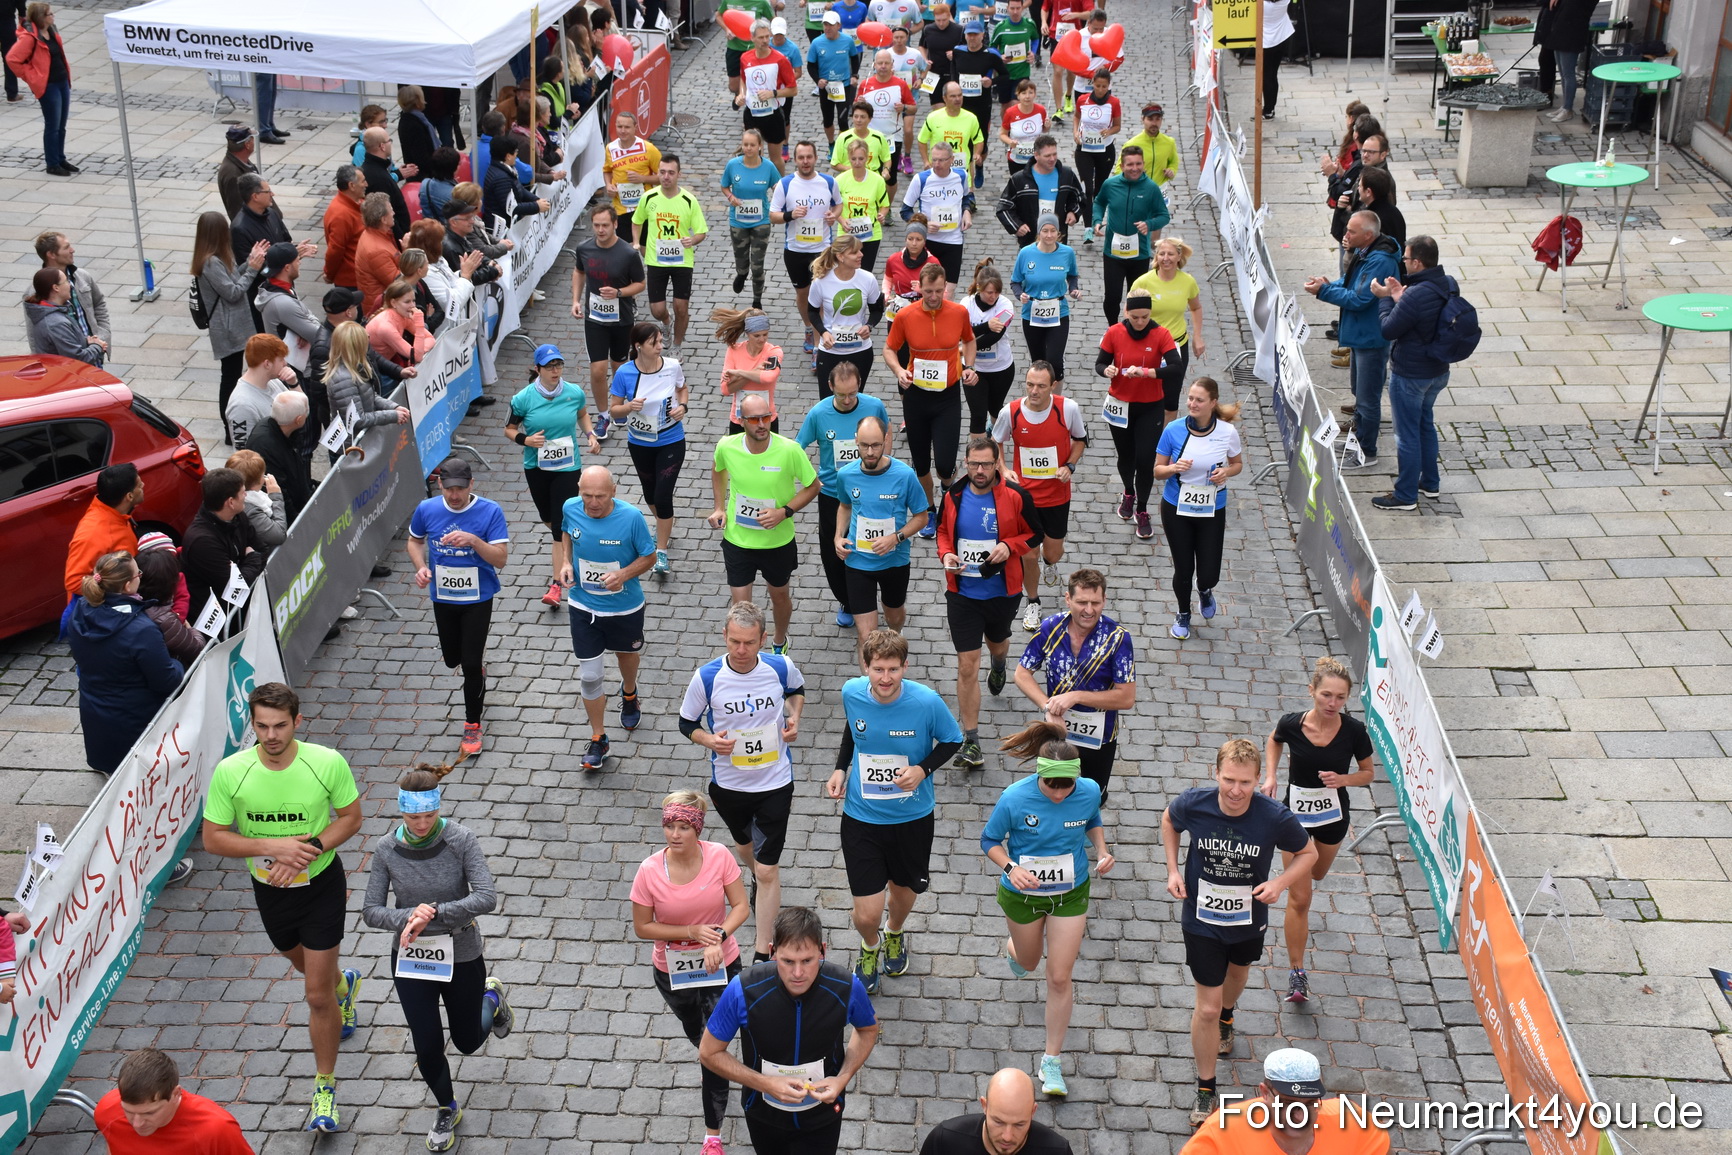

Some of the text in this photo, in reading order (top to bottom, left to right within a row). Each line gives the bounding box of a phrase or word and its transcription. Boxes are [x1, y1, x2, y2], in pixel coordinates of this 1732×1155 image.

[1228, 7, 1250, 19] lauf
[123, 24, 314, 53] BMW ConnectedDrive
[126, 43, 272, 64] Vernetzt, um frei zu sein.
[1010, 49, 1021, 57] 175
[962, 81, 979, 89] 2165
[752, 99, 769, 109] 2173
[1085, 136, 1102, 144] 2914
[612, 155, 648, 169] MAX BÖGL
[621, 189, 641, 199] 2622
[739, 206, 759, 214] 2440
[853, 207, 864, 216] M
[938, 213, 953, 222] 144
[663, 225, 675, 236] M
[801, 226, 817, 235] 211
[659, 247, 680, 256] 2046
[1119, 243, 1131, 251] 58
[593, 302, 615, 313] 2488
[892, 304, 903, 312] 12
[1034, 308, 1056, 317] 2237
[836, 332, 858, 342] 2554
[424, 347, 470, 405] RAILONE
[921, 369, 939, 380] 152
[630, 416, 652, 432] 2422
[327, 428, 341, 446] swn
[543, 447, 568, 460] 2361
[839, 449, 860, 460] 250
[1029, 456, 1049, 468] 166
[1184, 491, 1211, 504] 2431
[740, 504, 761, 517] 271
[864, 529, 885, 540] 301
[962, 551, 984, 563] 242
[442, 576, 473, 588] 2604
[275, 542, 326, 636] BOCK
[204, 608, 220, 631] swn
[1425, 629, 1440, 653] swn
[1064, 720, 1098, 736] 2137
[745, 739, 764, 755] 54
[1296, 798, 1333, 813] 2798
[246, 812, 307, 823] BRANDL
[1064, 819, 1087, 828] BOCK
[1197, 838, 1261, 858] AUCKLAND
[1209, 850, 1245, 861] UNIVERSITY
[21, 874, 35, 900] swn
[1205, 895, 1244, 911] 2205
[405, 946, 445, 962] 2020
[414, 963, 437, 971] Kristina
[675, 958, 705, 971] 217
[688, 972, 709, 980] Verena
[71, 965, 123, 1050] Service-Line:
[1514, 1017, 1523, 1033] die
[1518, 997, 1541, 1047] Neumarkts
